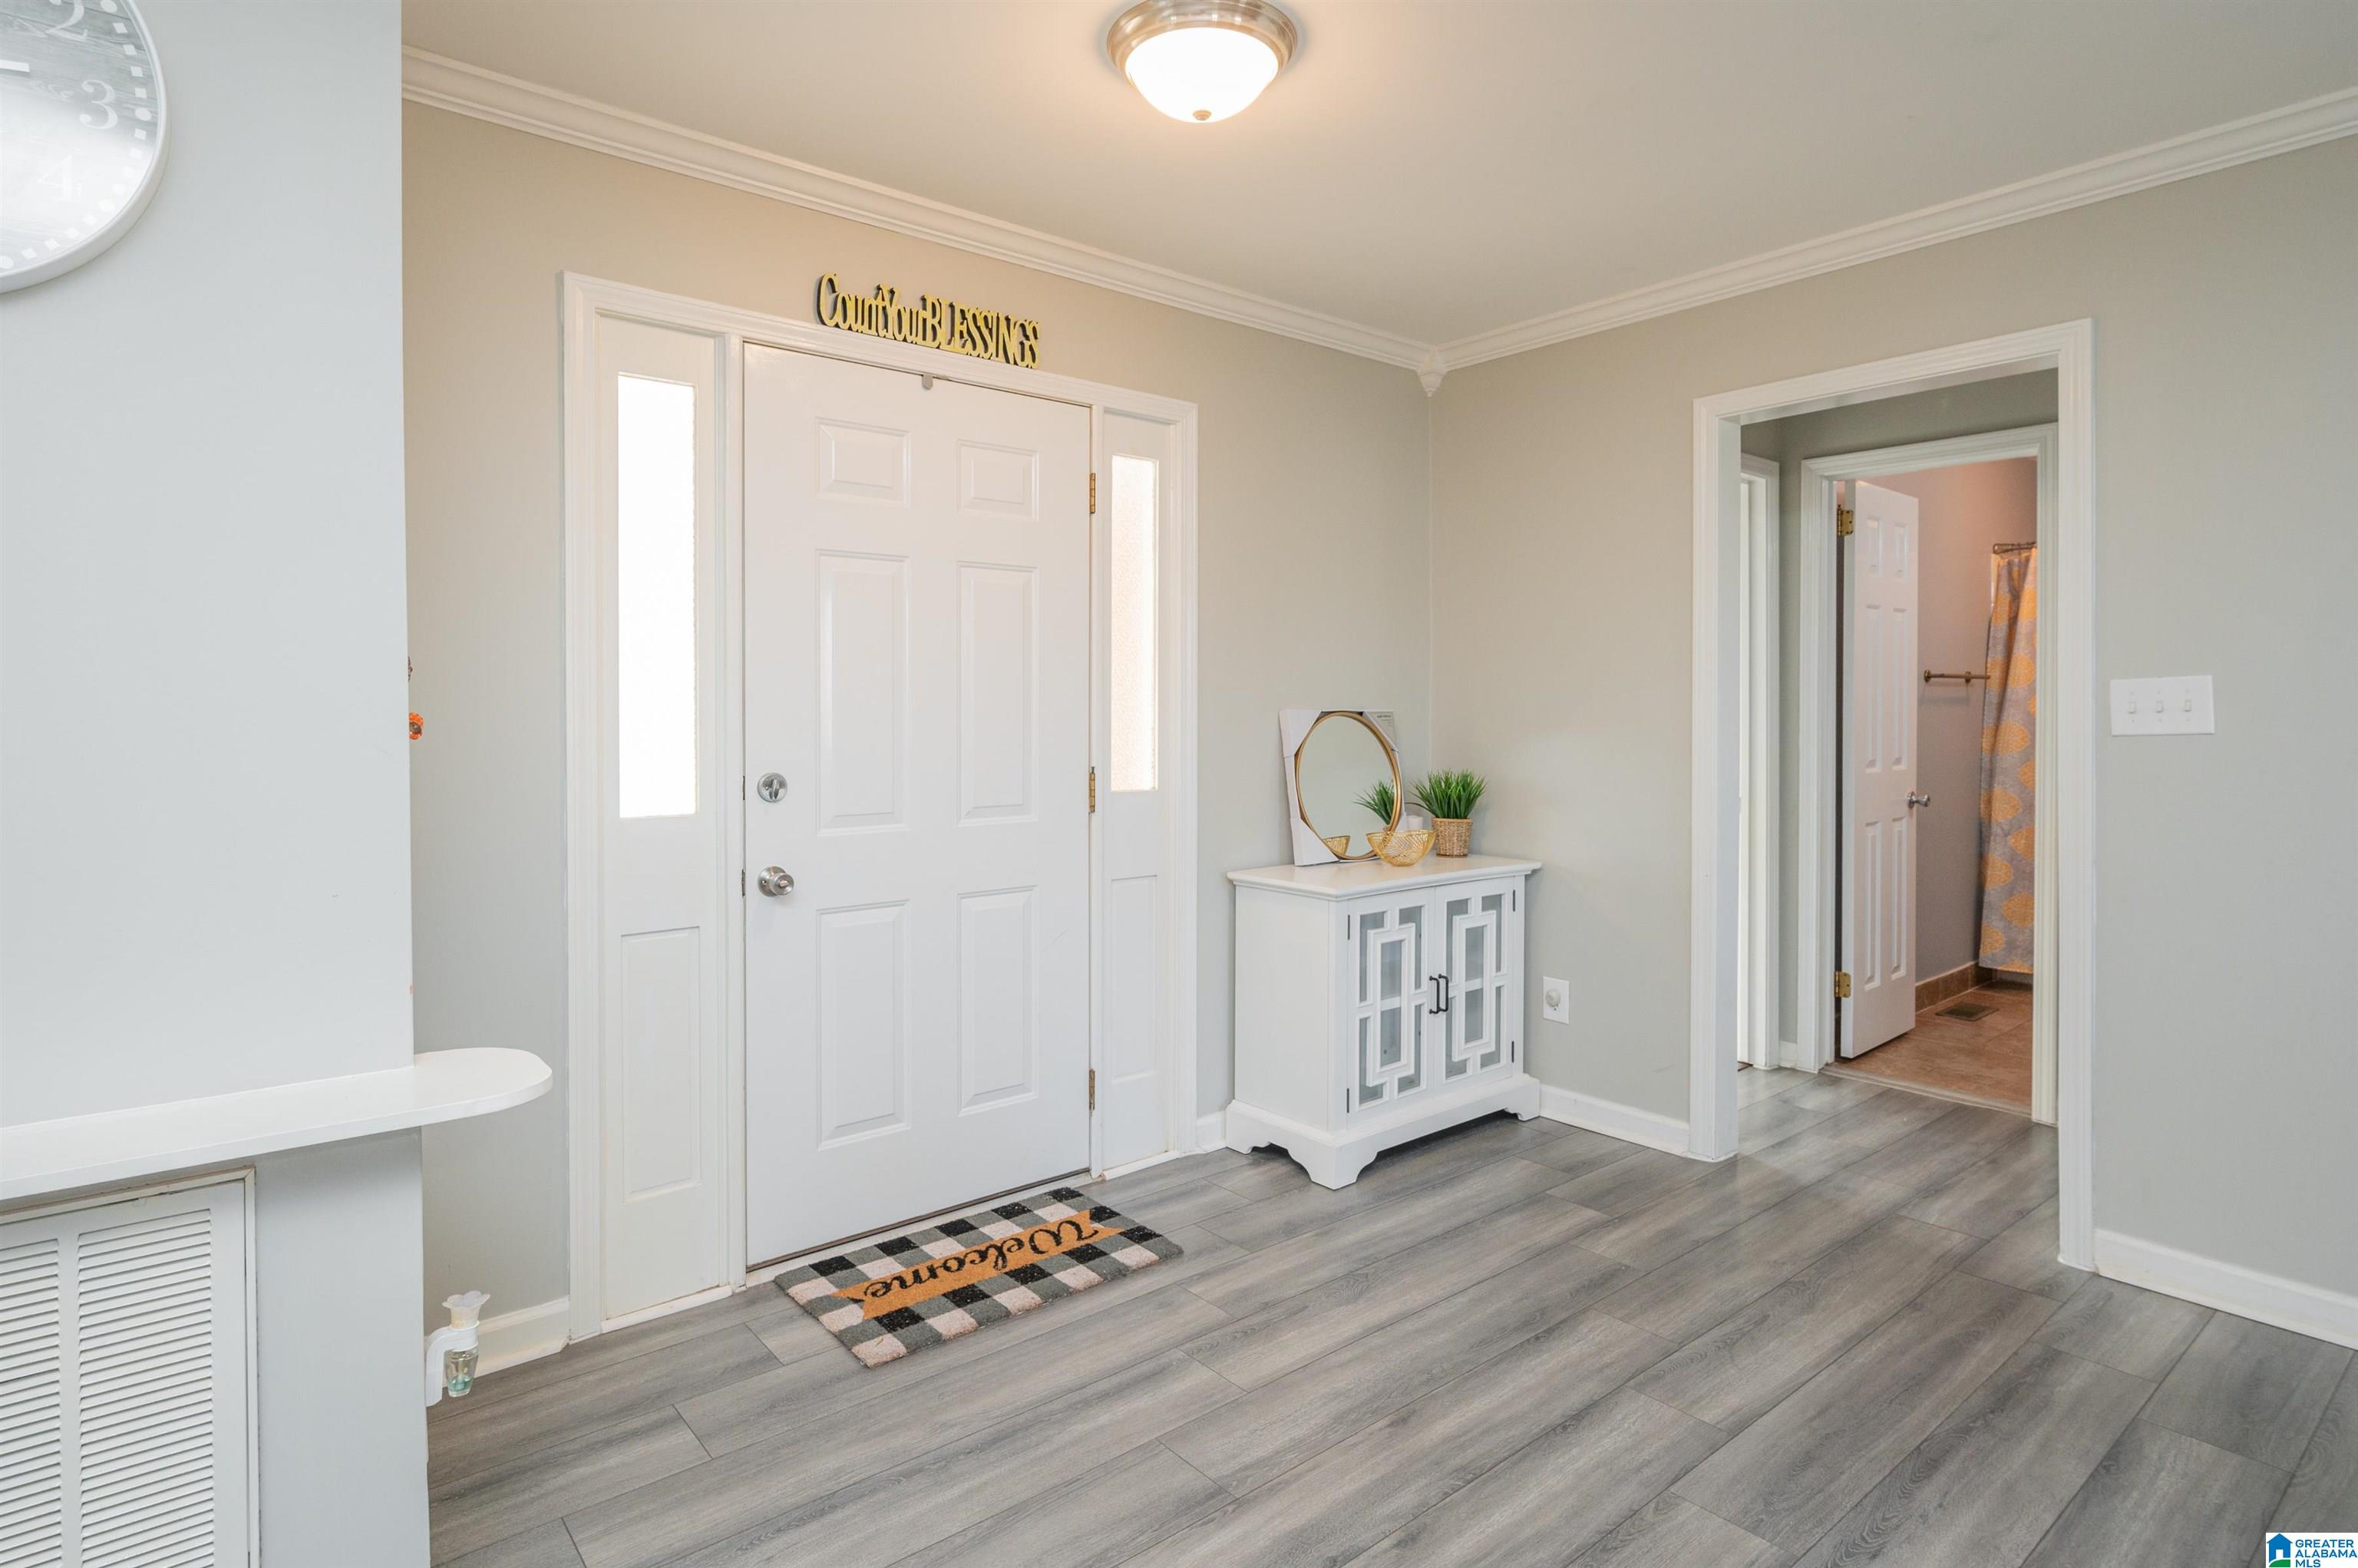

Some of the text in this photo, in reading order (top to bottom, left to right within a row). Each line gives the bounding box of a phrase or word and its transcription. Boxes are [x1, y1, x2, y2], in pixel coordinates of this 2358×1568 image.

[46, 0, 88, 41] 2
[80, 80, 118, 129] 3
[38, 154, 82, 203] 4
[864, 1220, 1098, 1299] Welcome
